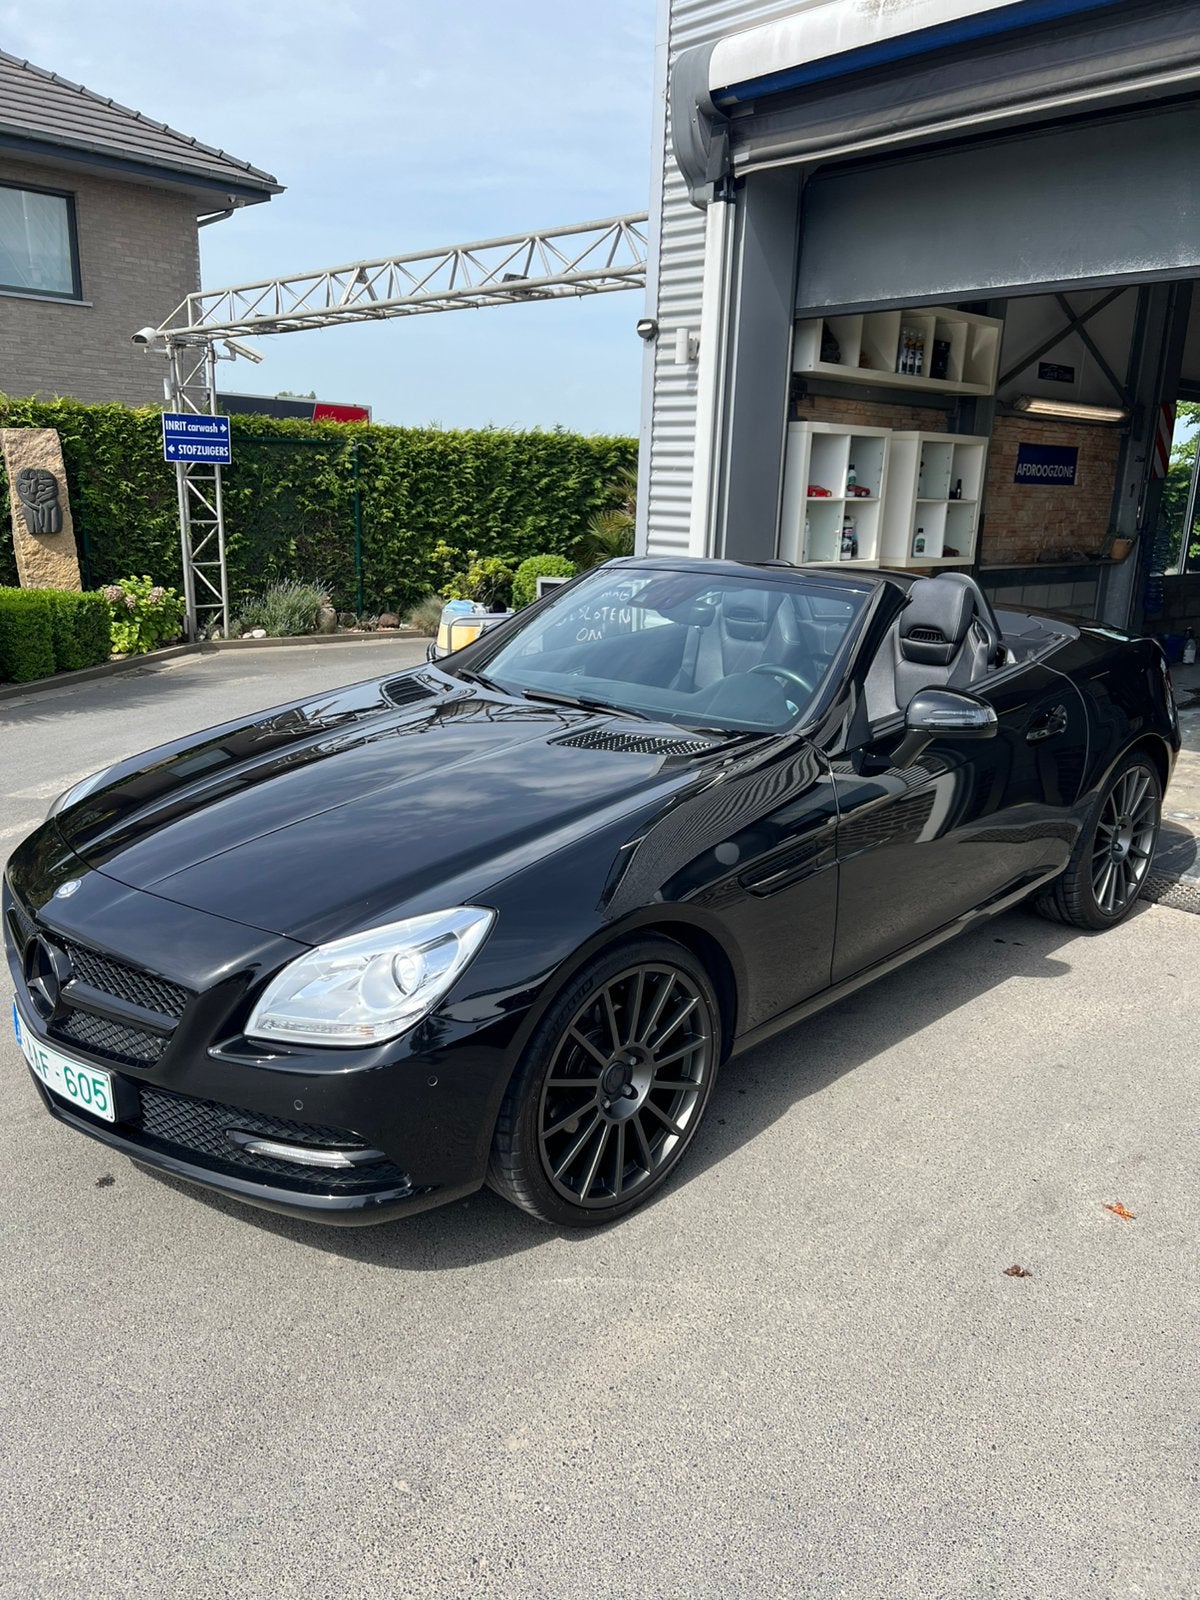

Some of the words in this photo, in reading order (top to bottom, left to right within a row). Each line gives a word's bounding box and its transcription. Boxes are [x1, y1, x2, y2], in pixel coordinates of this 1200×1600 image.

[165, 420, 187, 432] INRIT
[187, 422, 218, 433] carwash
[178, 444, 229, 457] STOFZUIGERS
[1016, 463, 1075, 478] AFDROOGZONE
